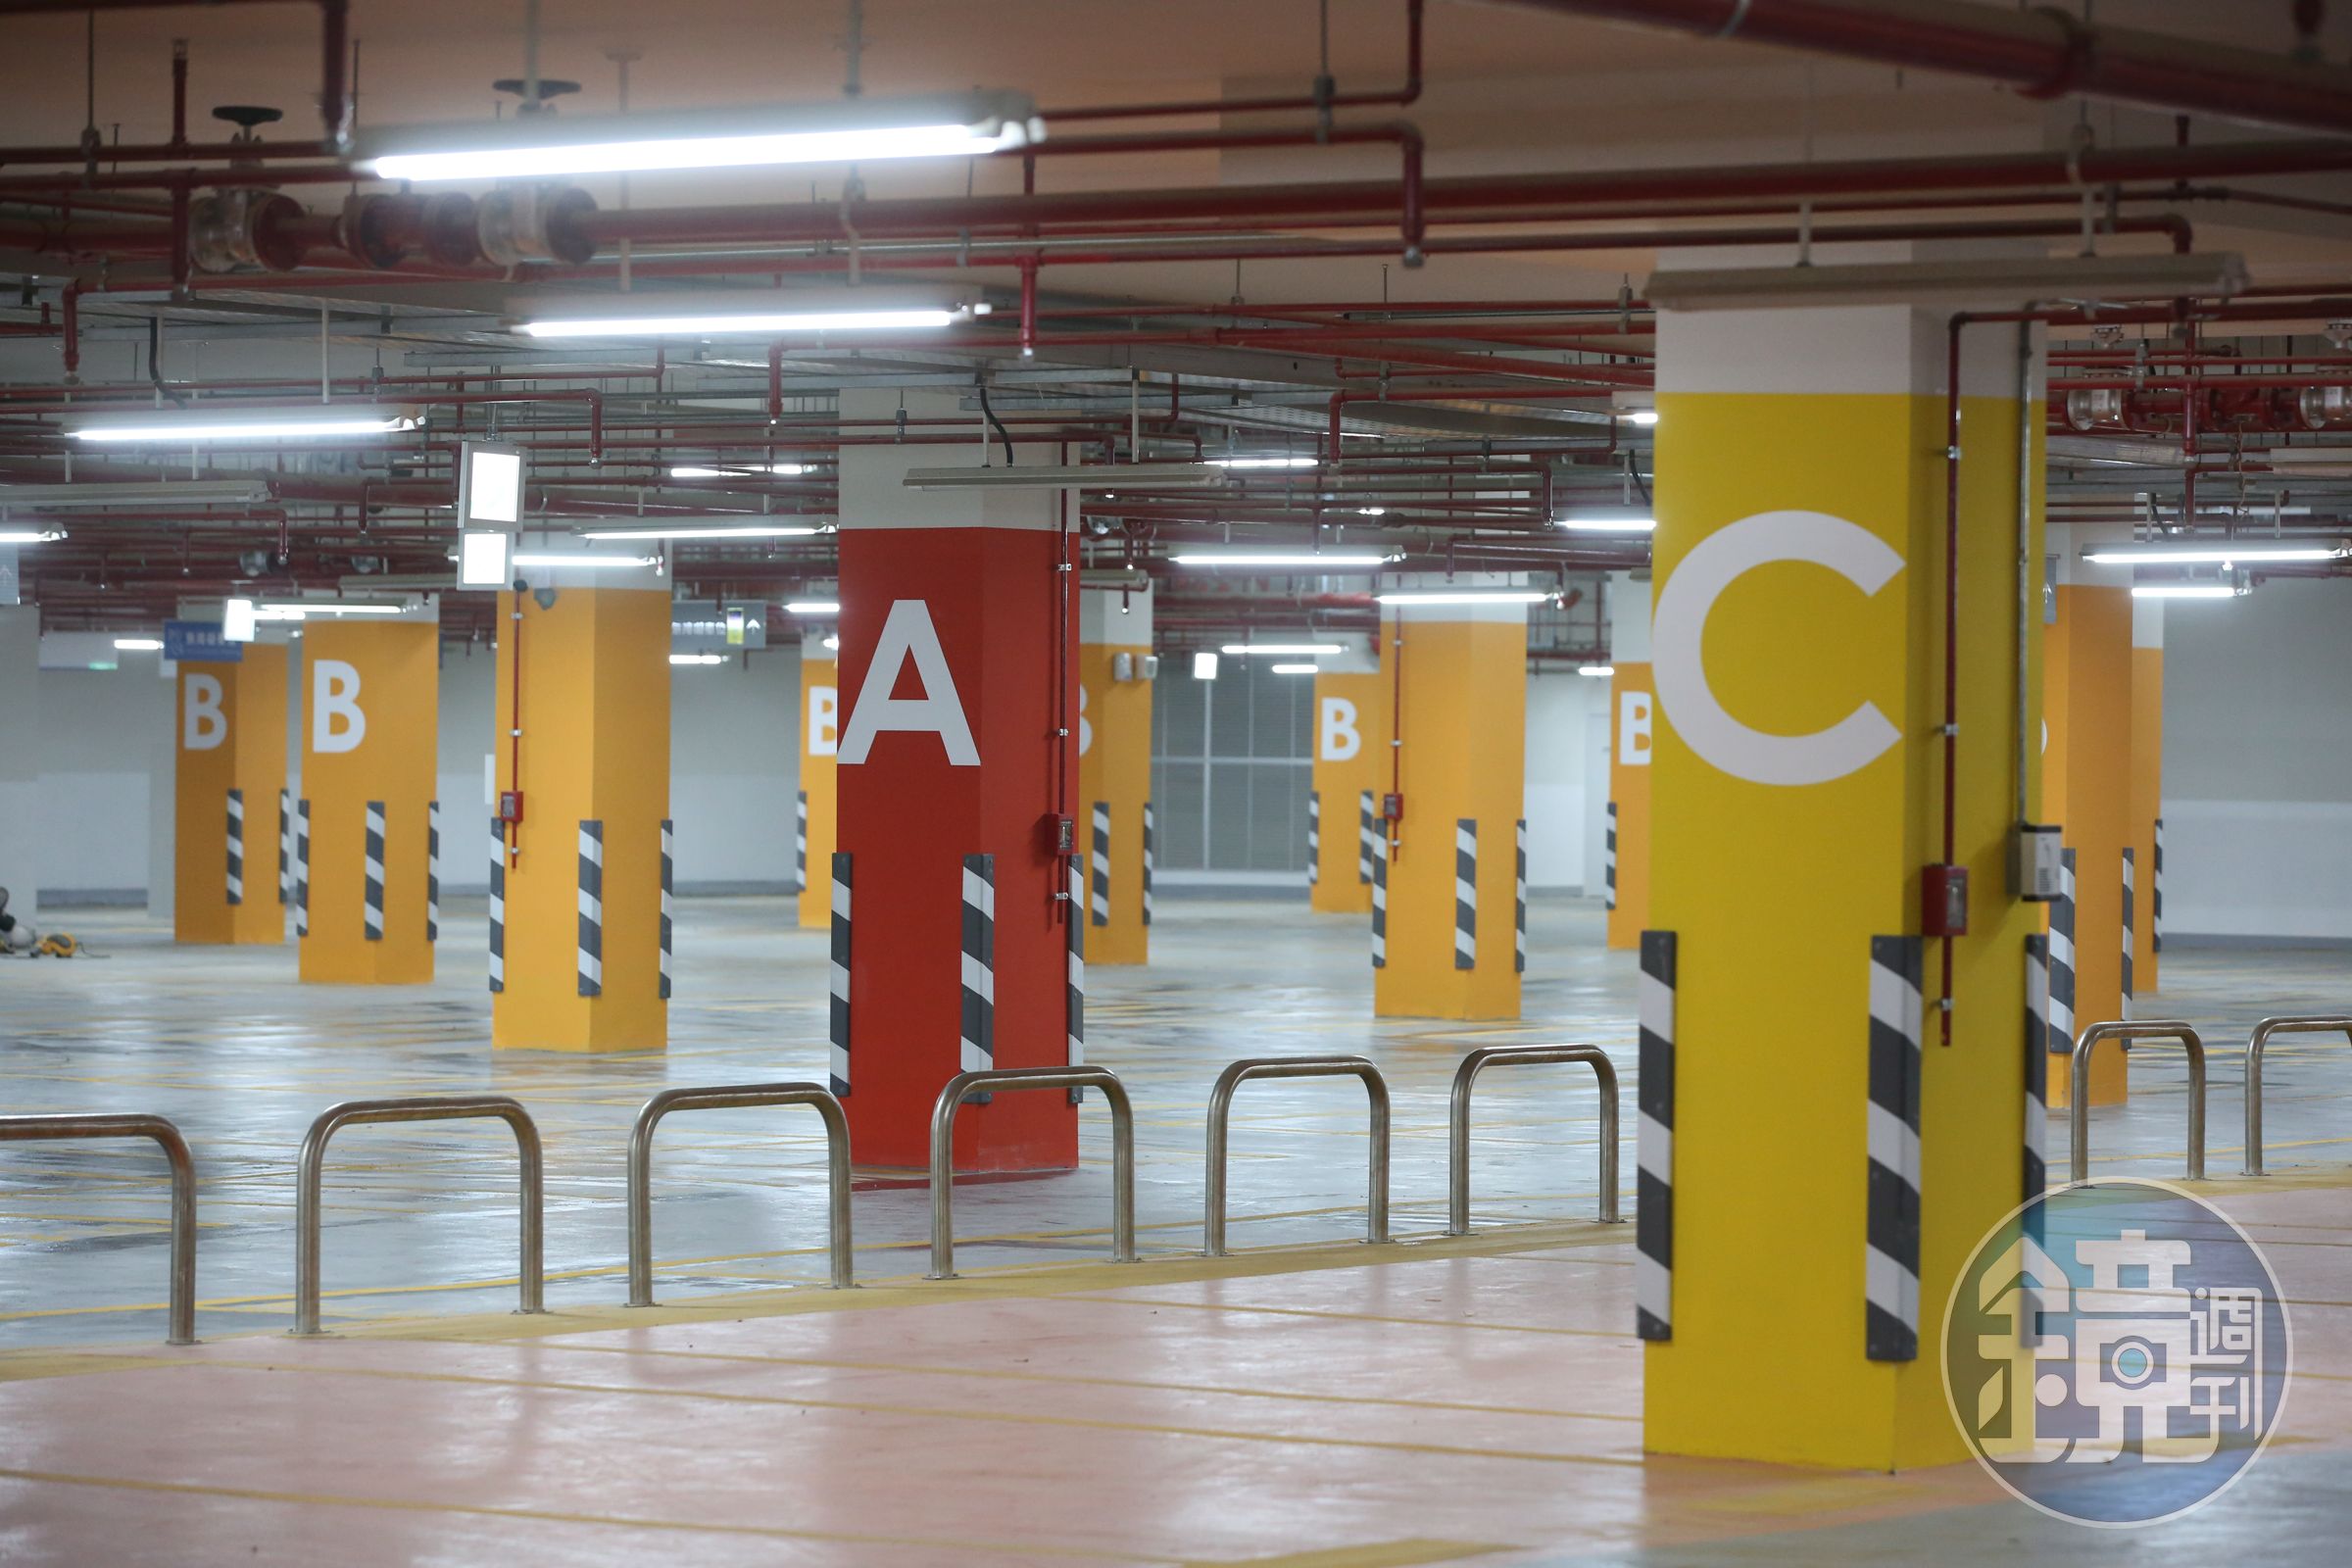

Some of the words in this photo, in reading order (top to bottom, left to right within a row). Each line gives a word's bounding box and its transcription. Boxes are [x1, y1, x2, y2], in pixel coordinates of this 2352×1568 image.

[837, 600, 982, 766] A
[1651, 510, 1906, 786] C
[184, 673, 227, 751] B
[313, 660, 367, 753] B
[808, 686, 838, 756] B
[1321, 697, 1361, 760] B
[1620, 691, 1651, 764] B
